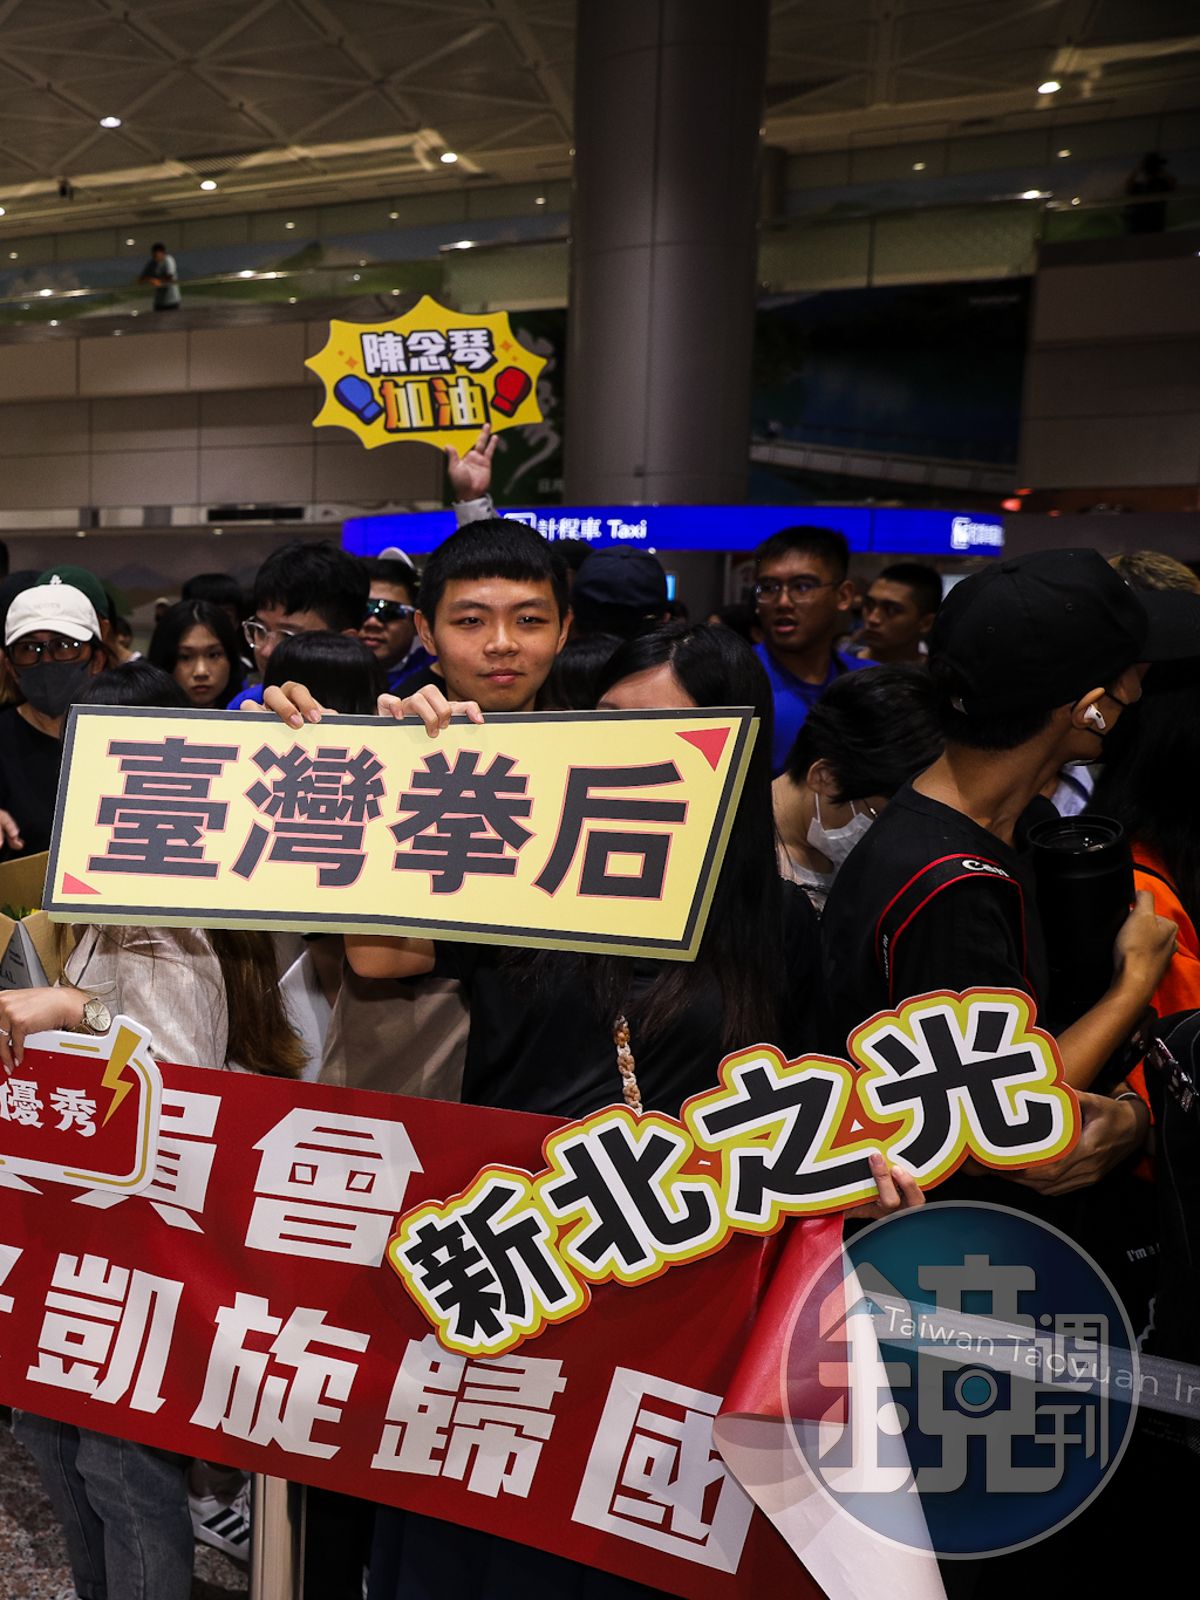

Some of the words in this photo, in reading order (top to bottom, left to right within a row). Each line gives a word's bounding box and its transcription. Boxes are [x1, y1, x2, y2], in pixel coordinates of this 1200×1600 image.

[361, 328, 497, 375] 陳念琴
[381, 377, 489, 431] 加油
[537, 517, 602, 541] 計程車
[606, 518, 648, 540] Taxi
[87, 736, 690, 900] 臺灣拳后
[402, 1009, 1055, 1342] 新北之光
[884, 1304, 995, 1356] Taiwan
[1005, 1334, 1160, 1396] Taoyuan
